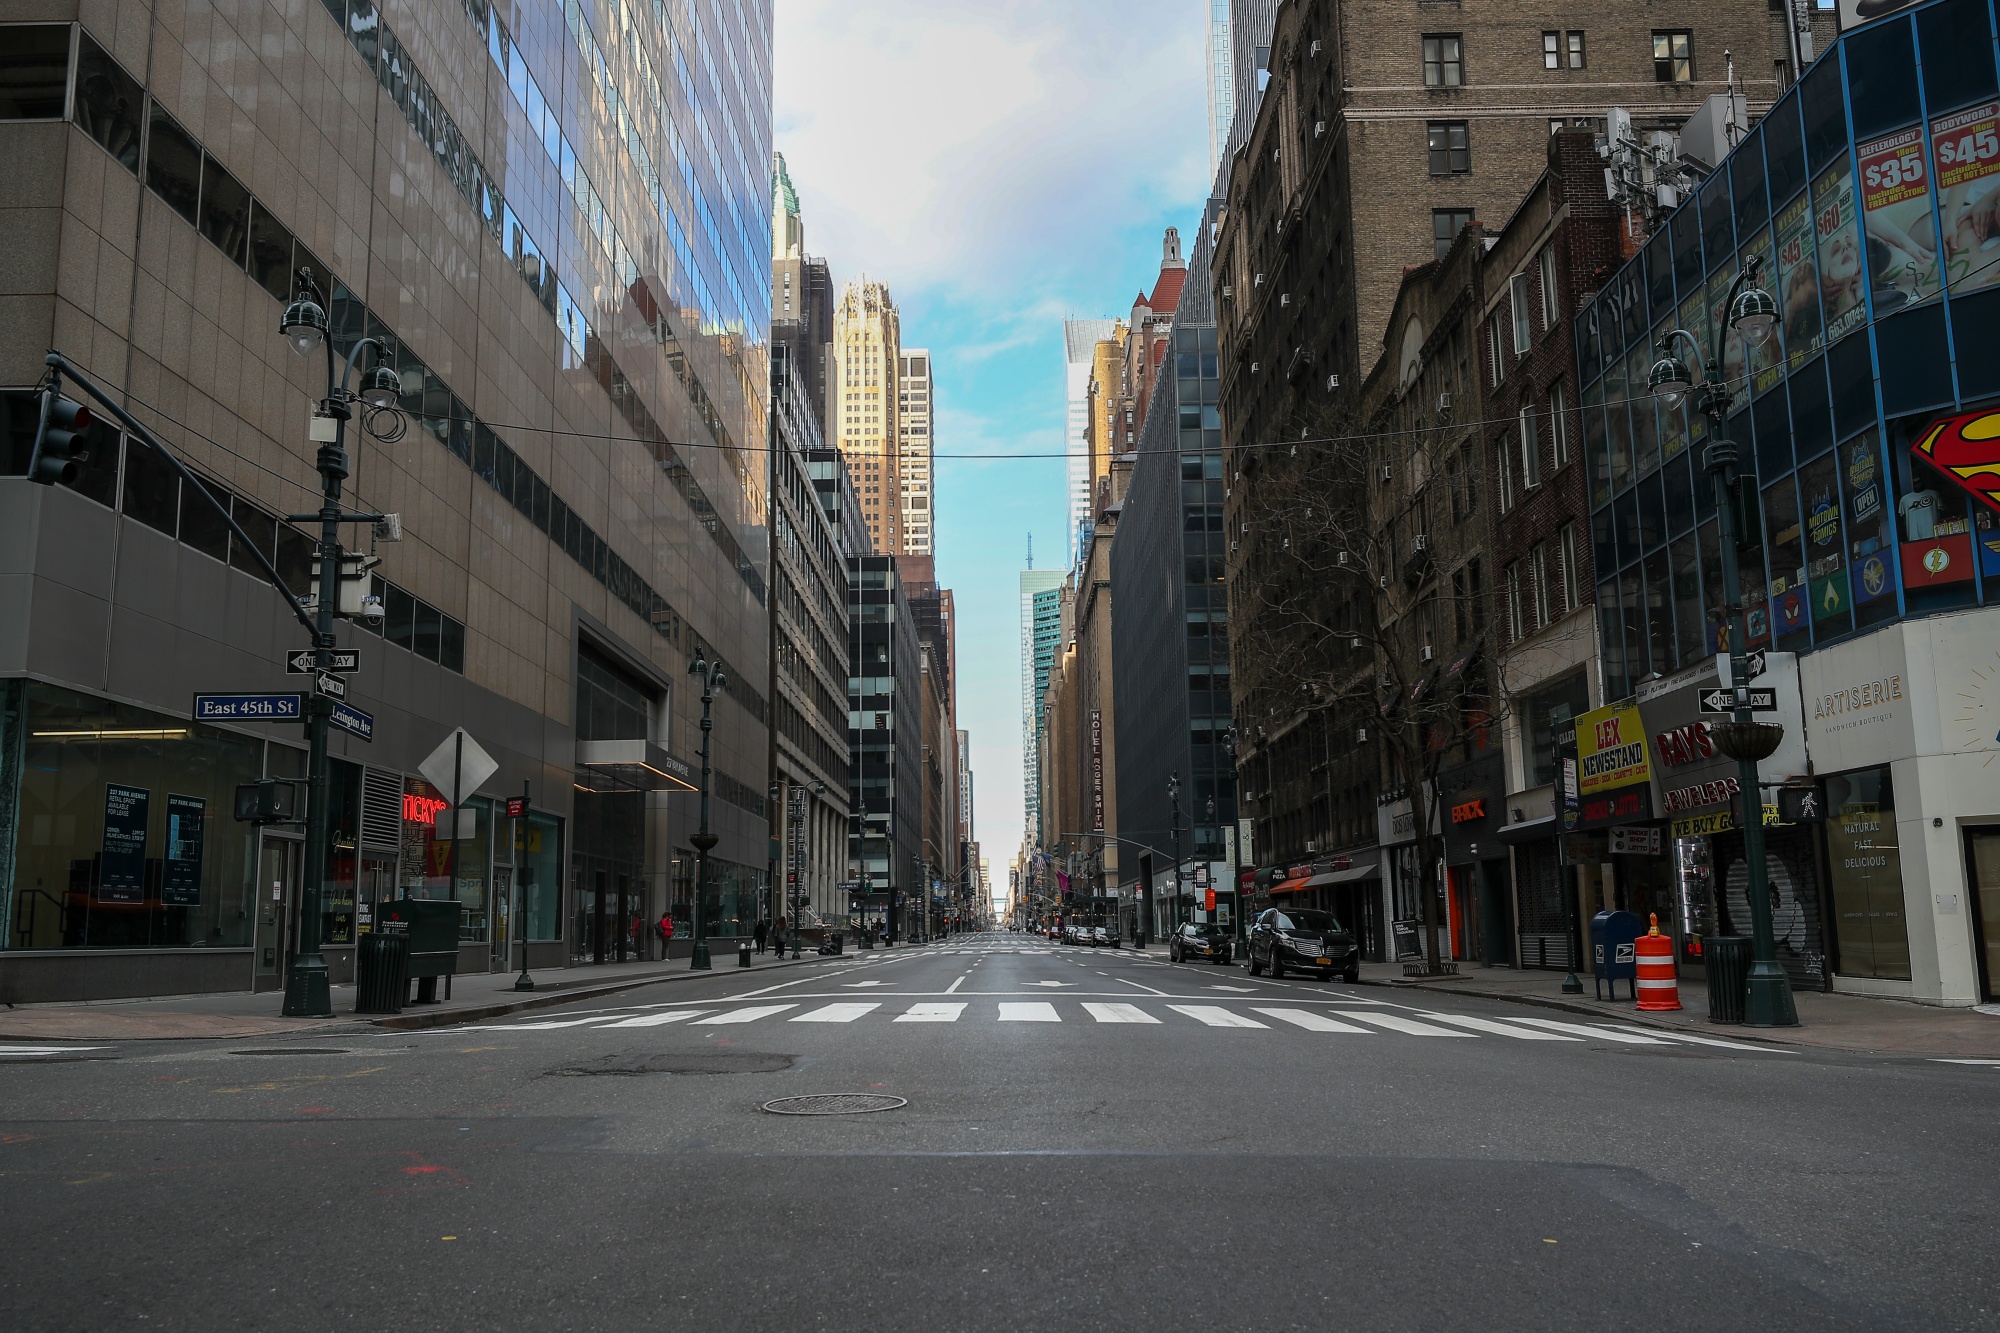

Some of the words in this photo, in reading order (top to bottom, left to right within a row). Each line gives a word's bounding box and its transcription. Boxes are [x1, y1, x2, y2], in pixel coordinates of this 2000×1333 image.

[1934, 107, 1993, 132] BODYWORK
[1860, 131, 1916, 156] REFLEXOLOGY
[1939, 128, 1998, 164] $45
[1866, 152, 1922, 188] $35
[1942, 162, 1982, 178] Includes
[1942, 174, 1962, 186] FREE
[1964, 170, 1978, 180] HOT
[1868, 185, 1906, 201] Includes
[1868, 197, 1887, 209] FREE
[1889, 192, 1902, 202] HOT
[1904, 186, 1926, 198] STONE
[1818, 202, 1840, 236] $60
[1782, 236, 1800, 266] $45
[1828, 302, 1866, 340] 663.0045
[1758, 368, 1777, 392] OPEN
[1857, 489, 1875, 512] OPEN
[1808, 504, 1838, 530] MIDTOWN
[1814, 522, 1837, 543] COMICS
[333, 656, 352, 666] AY
[1638, 690, 1648, 698] GOLD
[1650, 682, 1668, 693] PLATINUM
[1670, 678, 1678, 688] FINE
[1678, 671, 1696, 684] DIAMONDS
[1700, 662, 1716, 674] WATCHES
[203, 701, 236, 715] East
[241, 700, 273, 714] 45th
[278, 700, 294, 714] St
[1712, 696, 1733, 705] ONE
[1752, 695, 1766, 704] AY
[1815, 675, 1902, 720] ARTISERIE
[332, 705, 360, 729] Lexington
[360, 719, 371, 734] Ave
[1826, 722, 1856, 734] SANDWICH
[1860, 712, 1892, 726] BOUTIQUE
[1092, 712, 1100, 754] HOTEL
[1559, 730, 1576, 745] ELLER
[1595, 717, 1622, 752] LEX
[1656, 722, 1715, 767] RAYS
[1582, 742, 1644, 778] NEWSSTAND
[1581, 777, 1598, 788] MAGAZINES
[1602, 774, 1611, 784] SODA
[1614, 768, 1632, 780] CIGARETTE
[1636, 765, 1648, 775] CANDY
[1664, 777, 1740, 812] JEWELERS
[1452, 800, 1485, 824] BRICK
[1584, 800, 1609, 822] SMOKE
[1614, 796, 1639, 817] LOTTO
[1672, 821, 1690, 837] WE
[1692, 815, 1717, 834] BUY
[1844, 822, 1880, 834] NATURAL
[1651, 830, 1659, 852] ATM
[1854, 840, 1872, 850] FAST
[1845, 856, 1886, 868] DELICIOUS
